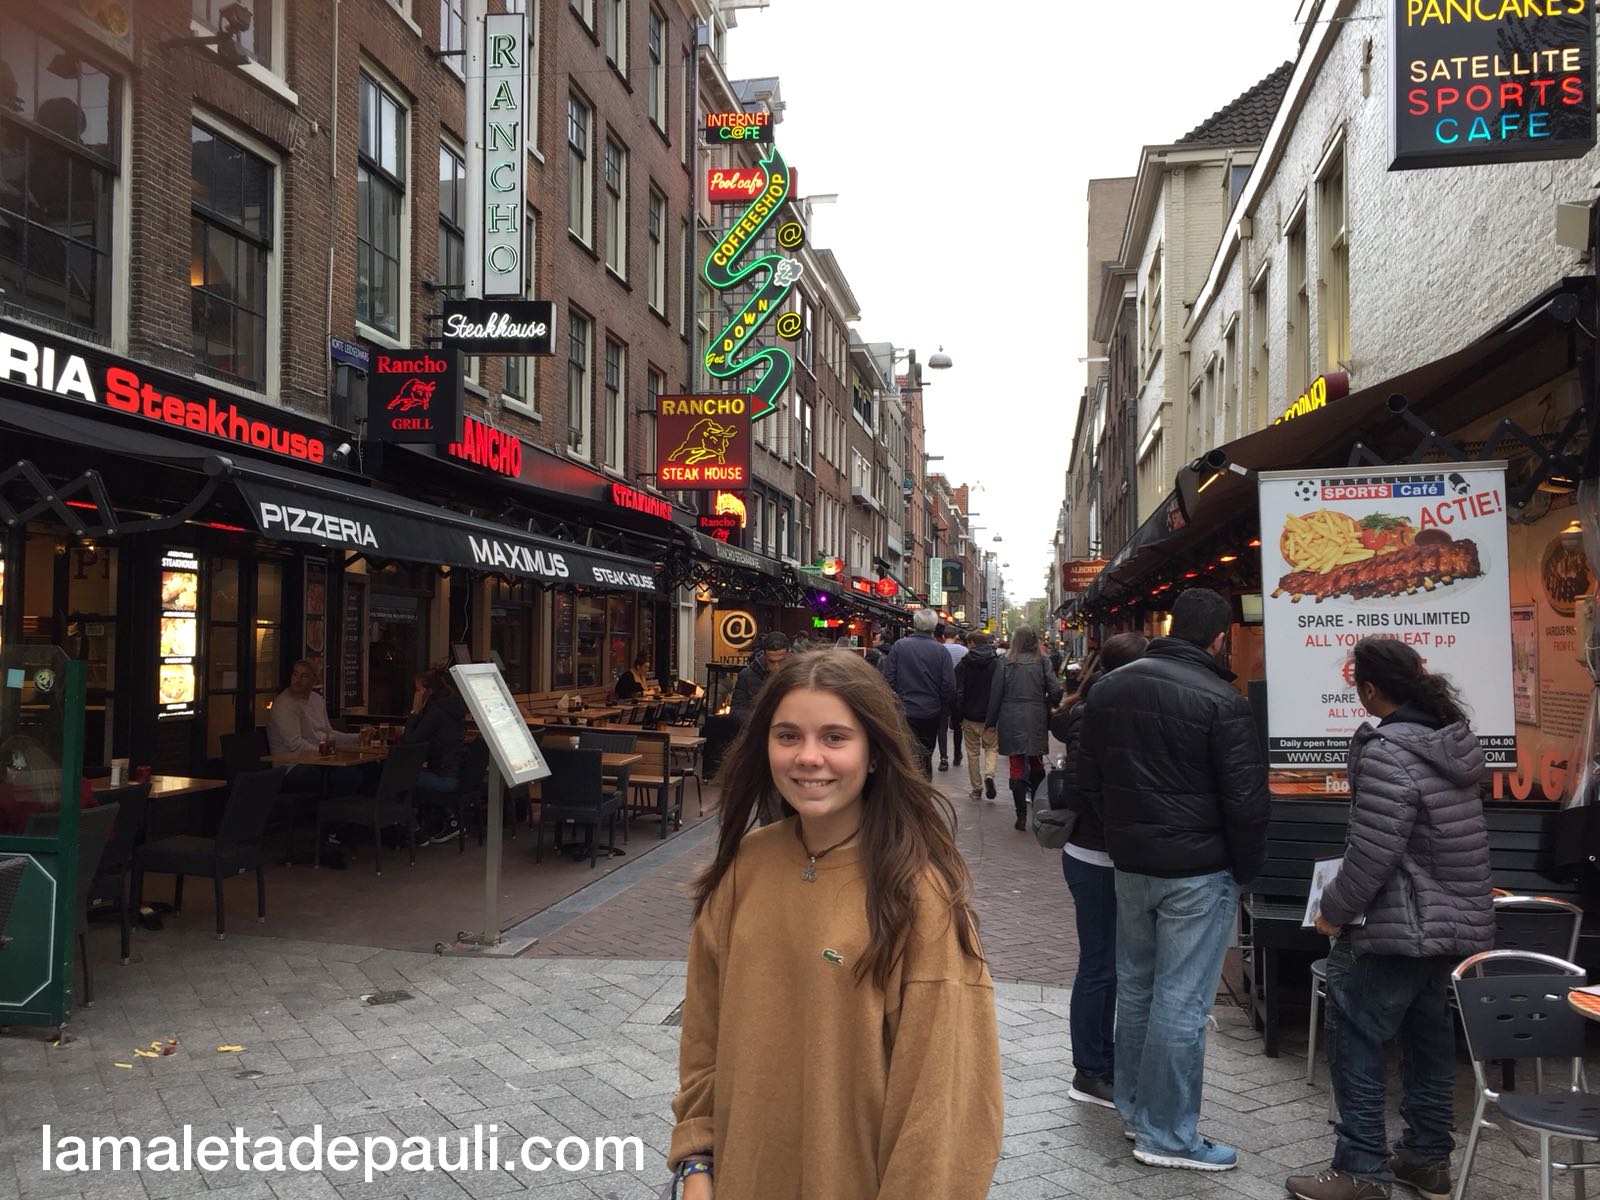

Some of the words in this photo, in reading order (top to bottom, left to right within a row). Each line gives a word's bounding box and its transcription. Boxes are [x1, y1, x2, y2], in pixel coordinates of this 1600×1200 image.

[1407, 0, 1586, 27] PANCAKES
[1409, 48, 1582, 83] SATELLITE
[1408, 76, 1584, 116] SPORTS
[707, 112, 770, 127] INTERNET
[1435, 111, 1551, 144] CAFE
[720, 126, 760, 140] C@FE
[487, 33, 520, 275] RANCHO
[710, 172, 740, 191] Pool
[713, 173, 785, 266] COFFEESHOP
[443, 312, 546, 339] Steakhouse
[723, 299, 768, 351] DOWN
[0, 333, 97, 402] RIA
[377, 355, 447, 374] Rancho
[105, 367, 325, 463] Steakhouse
[662, 398, 745, 416] RANCHO
[391, 418, 433, 430] GRILL
[448, 417, 522, 479] ANCHO
[663, 466, 700, 480] STEAK
[704, 466, 743, 480] HOUSE
[1324, 475, 1440, 486] SATELLITE
[1323, 486, 1389, 500] SPORTS
[1400, 483, 1439, 496] Café
[612, 483, 672, 521] STEAKHOUSE
[1419, 489, 1503, 531] ACTIE!
[260, 502, 379, 549] PIZZERIA
[701, 516, 736, 527] Rancho
[468, 535, 570, 577] MAXIMUS
[592, 566, 629, 586] STEAK
[625, 570, 656, 590] HOUSE
[1298, 614, 1344, 628] SPARE
[1356, 613, 1390, 627] RIBS
[1393, 611, 1471, 626] UNLIMITED
[1305, 634, 1332, 647] ALL
[1404, 632, 1431, 646] EAT
[1434, 633, 1456, 648] p.p
[1321, 693, 1356, 704] SPARE
[1328, 708, 1348, 719] ALL
[1280, 739, 1301, 749] Daily
[1303, 741, 1325, 749] open
[1327, 739, 1347, 747] from
[1490, 738, 1514, 746] 04.00
[1287, 752, 1347, 763] WWW.SAT
